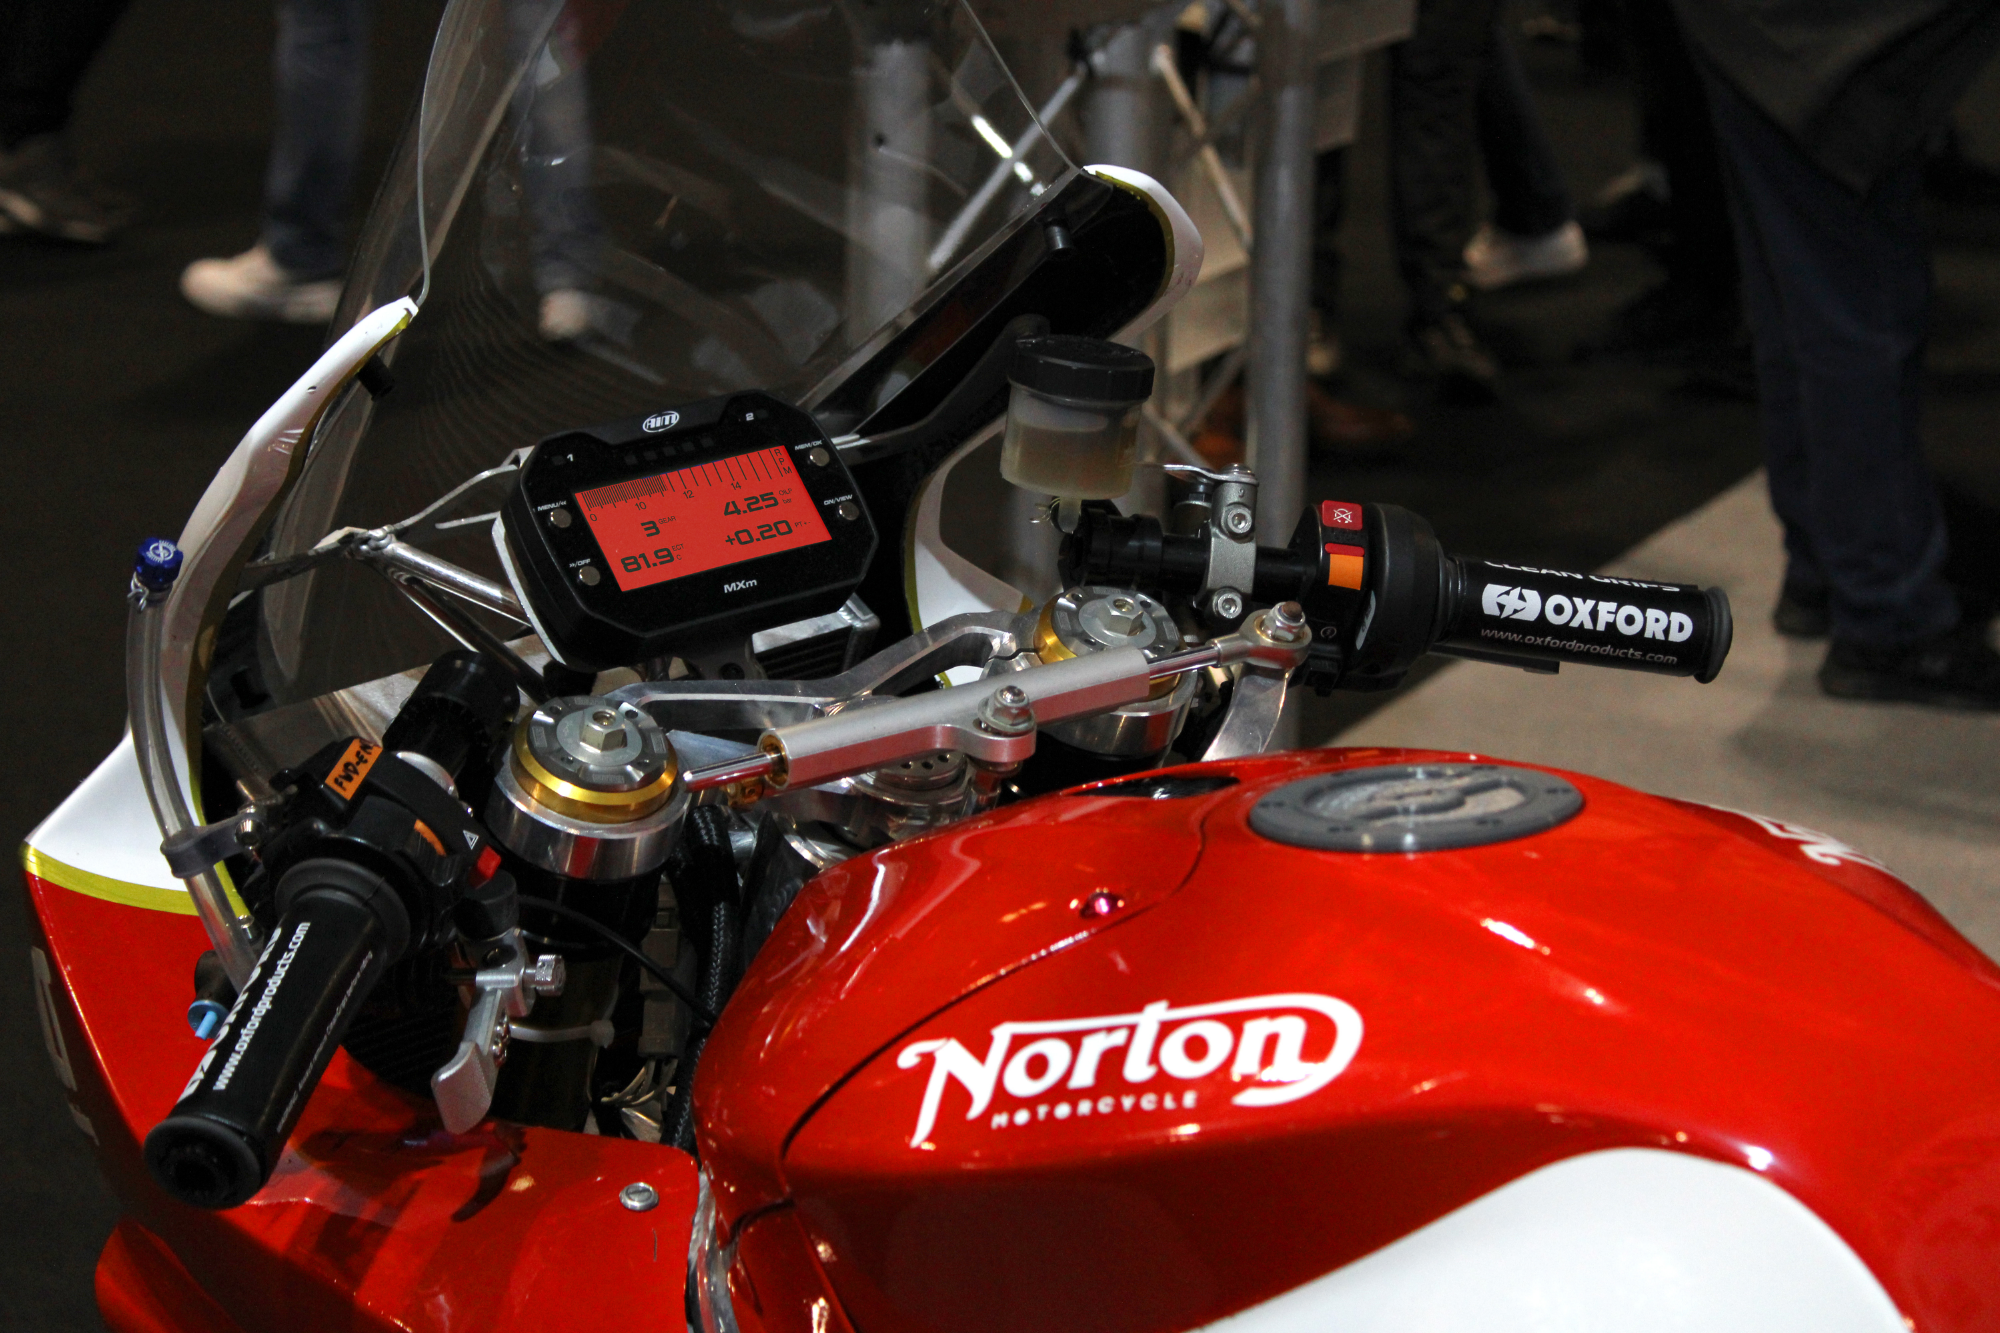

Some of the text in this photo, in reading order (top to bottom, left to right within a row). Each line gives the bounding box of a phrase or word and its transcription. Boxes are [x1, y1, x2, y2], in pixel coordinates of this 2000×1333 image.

[745, 412, 755, 421] 2
[566, 453, 574, 462] 1
[794, 440, 823, 451] MEM/OK
[634, 501, 647, 511] 10
[682, 490, 695, 500] 12
[730, 481, 742, 491] 14
[723, 491, 780, 517] 4.25
[823, 494, 853, 506] ON/VIEW
[640, 520, 660, 538] 3
[657, 515, 677, 525] GEAR
[724, 519, 793, 546] +0.20
[620, 547, 675, 573] 81.9
[671, 543, 685, 552] ECT
[723, 579, 757, 594] MXm
[1545, 594, 1694, 643] OXFORD
[1480, 629, 1678, 665] www.oxfordproducts.com
[212, 921, 311, 1091] www.oxfordproducts.com
[897, 993, 1364, 1148] Norton
[991, 1090, 1200, 1129] MOTORCYCLE
